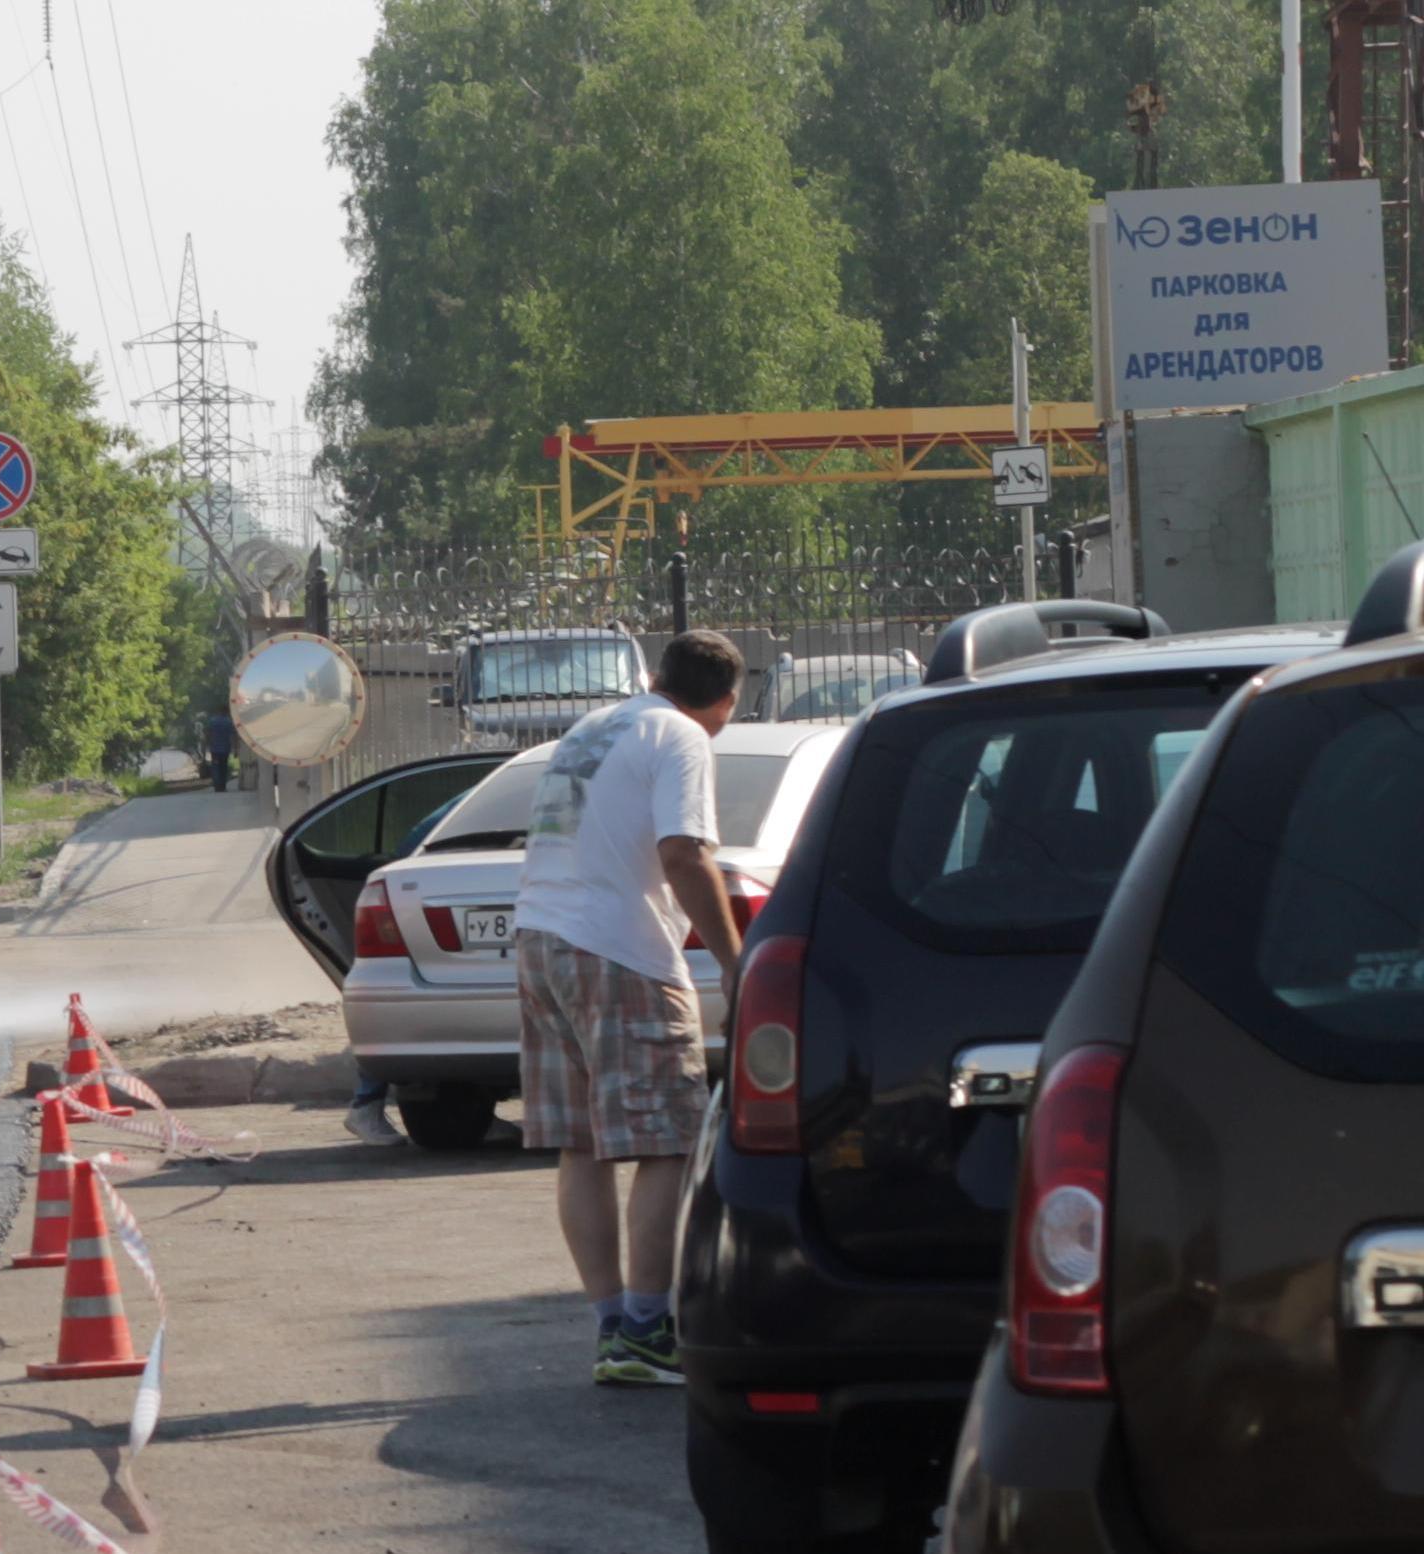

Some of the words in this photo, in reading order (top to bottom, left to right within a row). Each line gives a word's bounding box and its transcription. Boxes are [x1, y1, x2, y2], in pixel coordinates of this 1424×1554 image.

[1151, 271, 1288, 298] ПАРКОВКА
[1194, 312, 1250, 337] для
[1125, 345, 1324, 381] АРЕНДАТОРОВ
[477, 914, 514, 938] У8
